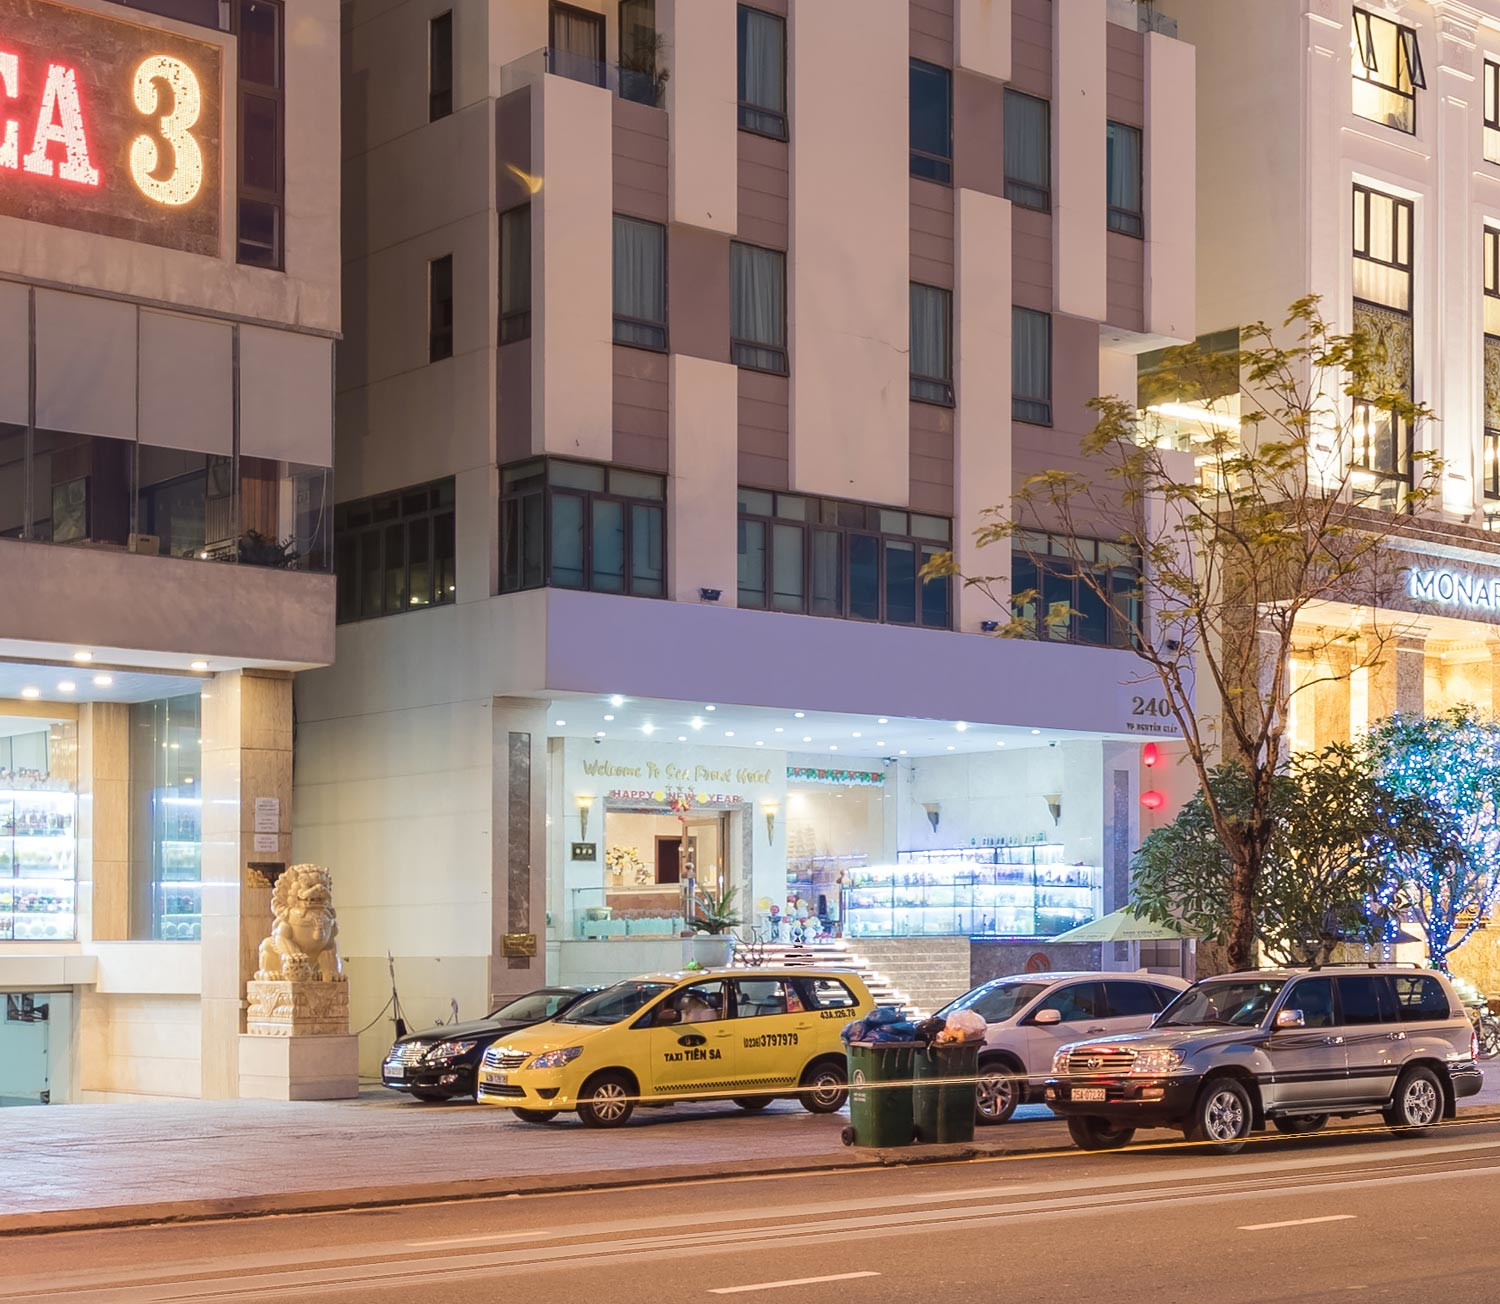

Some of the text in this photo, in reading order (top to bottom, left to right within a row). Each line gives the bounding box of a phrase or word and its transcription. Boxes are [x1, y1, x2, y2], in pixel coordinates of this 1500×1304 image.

[130, 55, 203, 206] 3
[1132, 696, 1171, 717] 240
[583, 759, 772, 783] Welcome To Sea Front Hotel
[613, 790, 740, 803] HAPPY NEW YEAR
[664, 1048, 721, 1062] TAXI TIÊN SA
